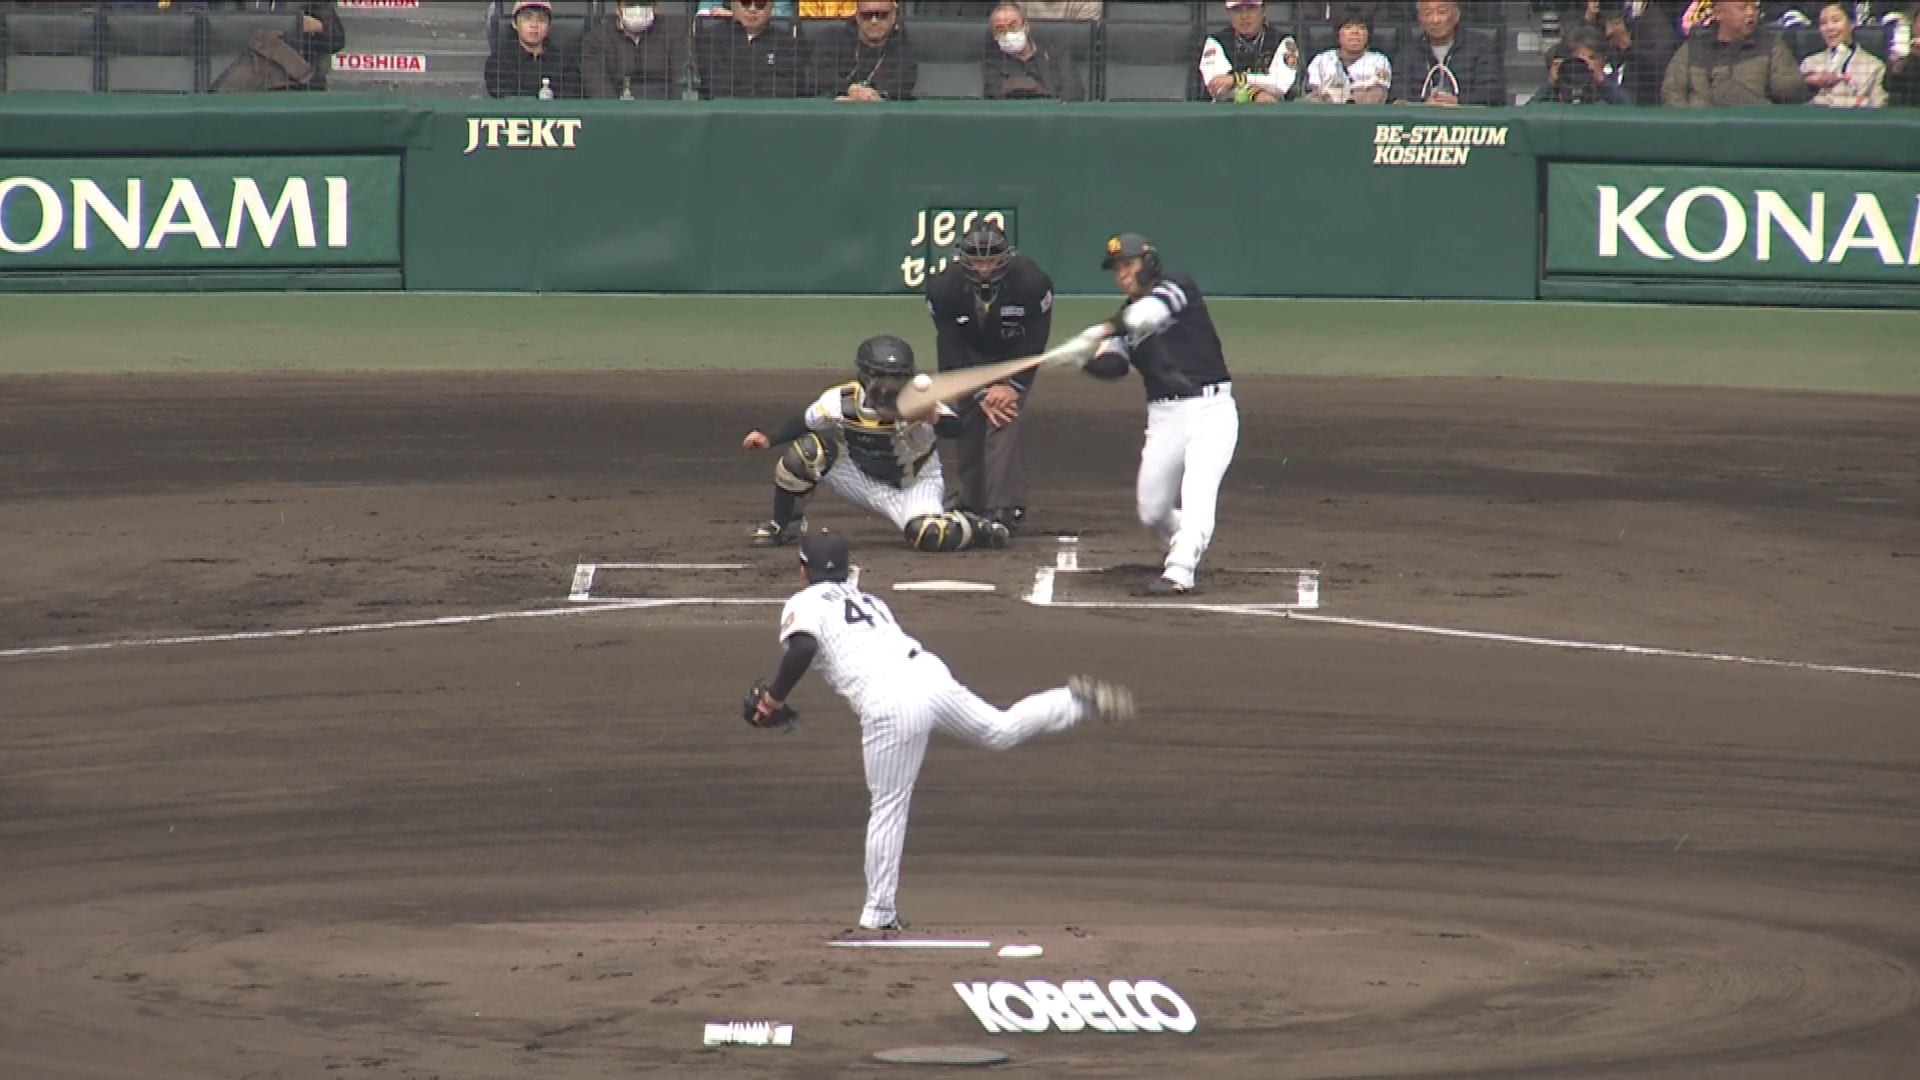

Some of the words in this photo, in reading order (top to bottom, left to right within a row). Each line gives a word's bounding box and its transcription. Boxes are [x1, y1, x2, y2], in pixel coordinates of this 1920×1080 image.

[336, 55, 421, 70] TOSHIBA
[463, 117, 582, 154] JTEKT
[1373, 125, 1509, 145] BE-STADIUM
[1373, 145, 1470, 165] KOSHIEN
[1596, 185, 1920, 266] KONA
[952, 979, 1197, 1033] KOBELCO
